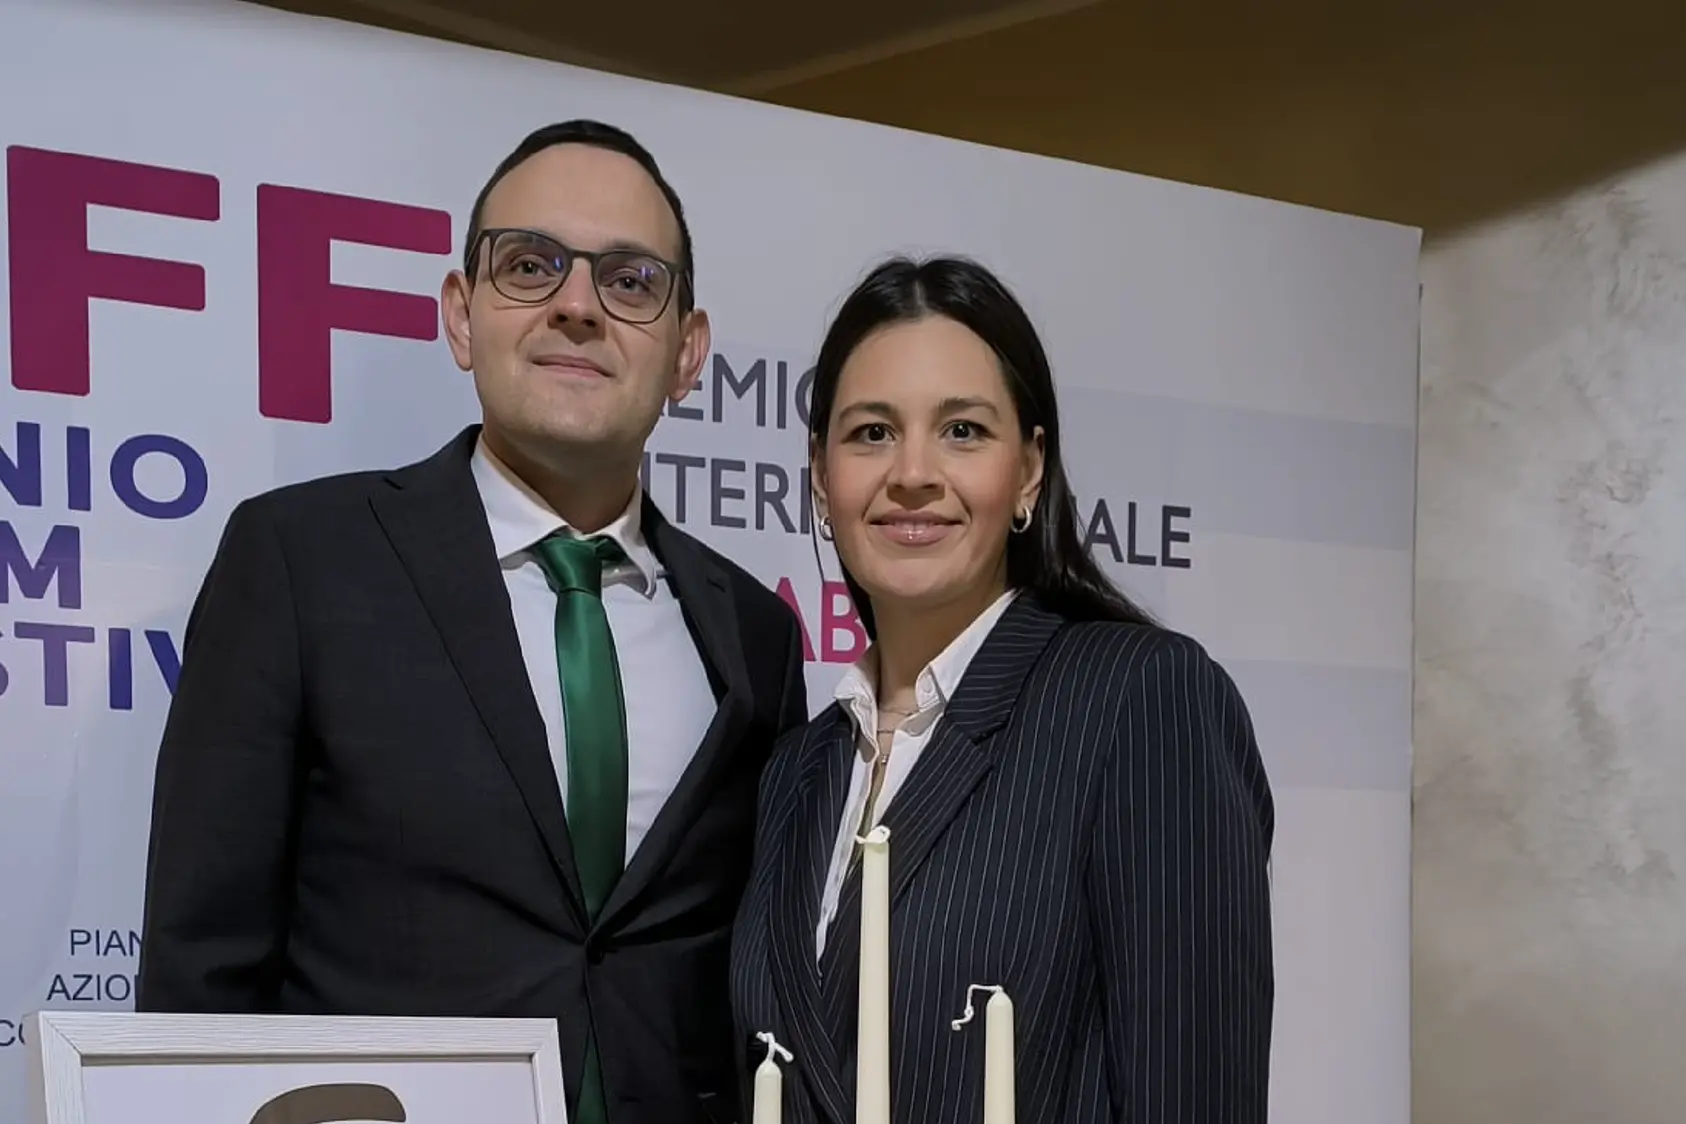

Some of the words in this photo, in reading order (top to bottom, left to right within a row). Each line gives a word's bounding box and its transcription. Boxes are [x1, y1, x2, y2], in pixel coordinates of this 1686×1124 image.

[6, 145, 452, 424] FF
[0, 621, 184, 710] TI
[46, 974, 140, 1001] AZIO
